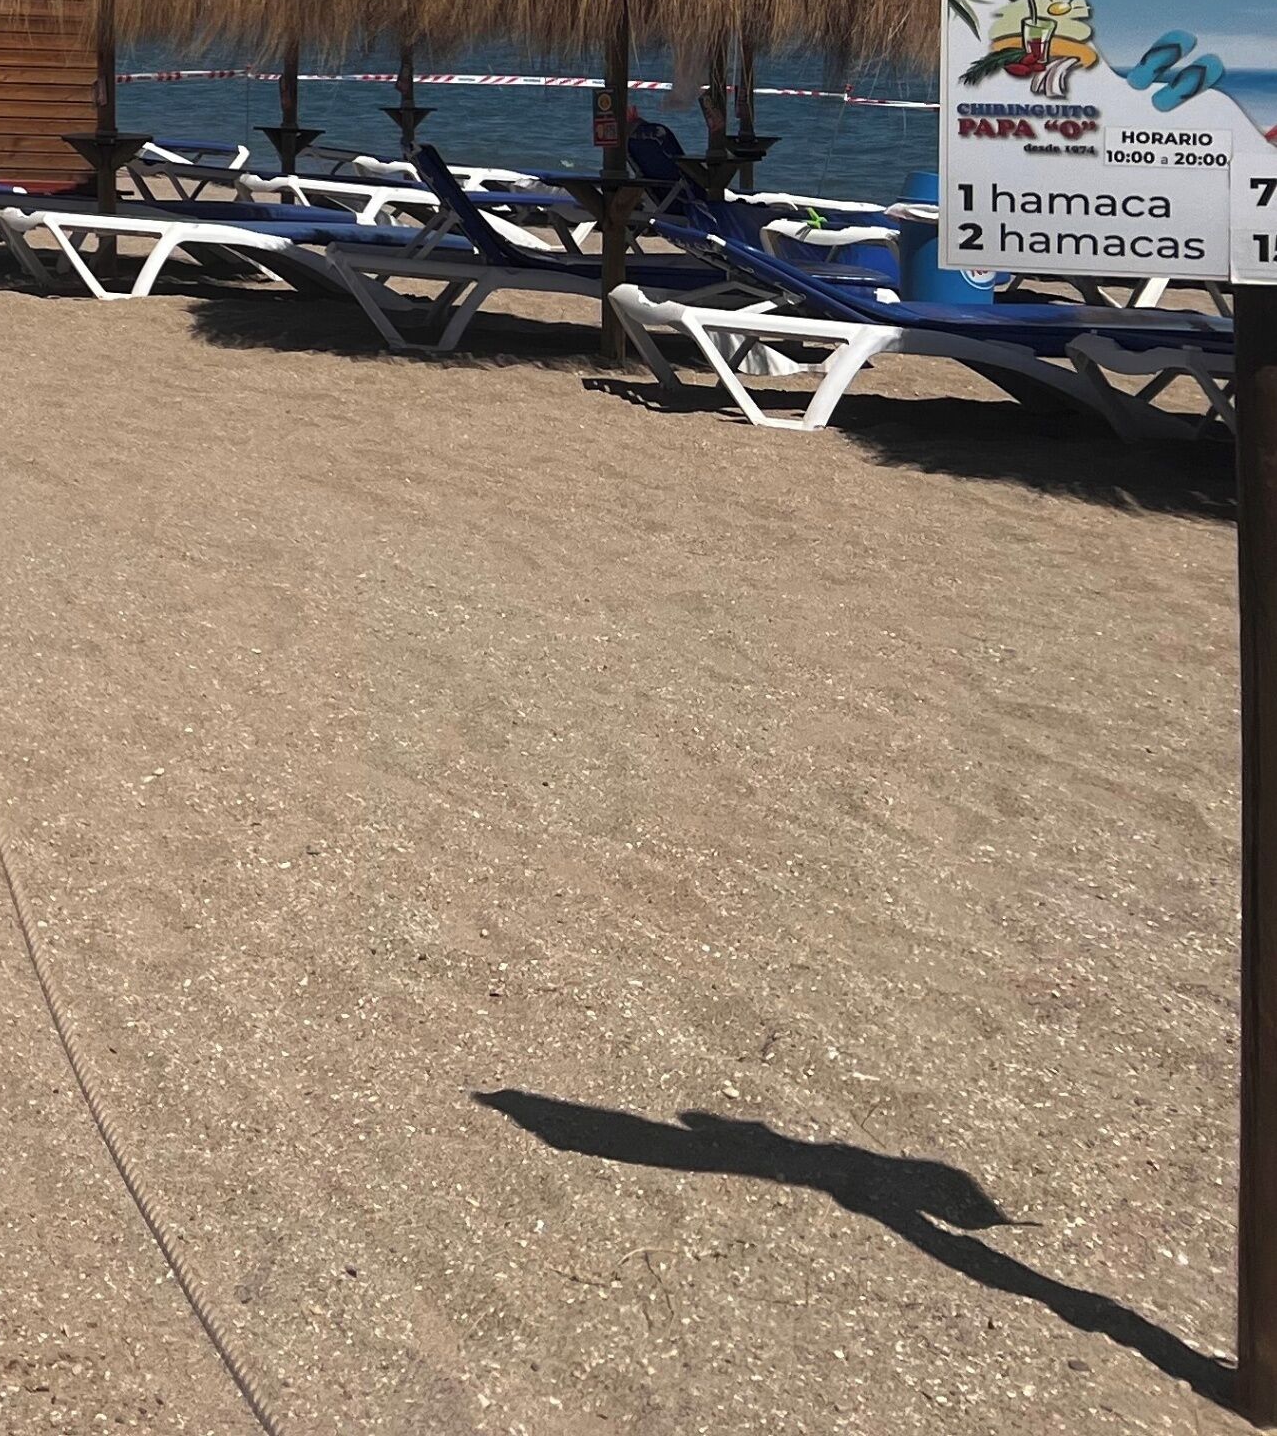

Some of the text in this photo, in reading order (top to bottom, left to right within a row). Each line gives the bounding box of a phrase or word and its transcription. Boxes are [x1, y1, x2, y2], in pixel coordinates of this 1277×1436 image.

[956, 103, 1099, 118] CHIRINGUITO
[957, 118, 1037, 139] PAPA
[1121, 130, 1213, 146] HORARIO
[1023, 144, 1096, 155] desde 1974
[1106, 150, 1227, 166] 10:00 a 20:00
[958, 183, 974, 211] 1
[991, 183, 1171, 218] hamaca
[958, 222, 1277, 262] 2 hamacas 1
